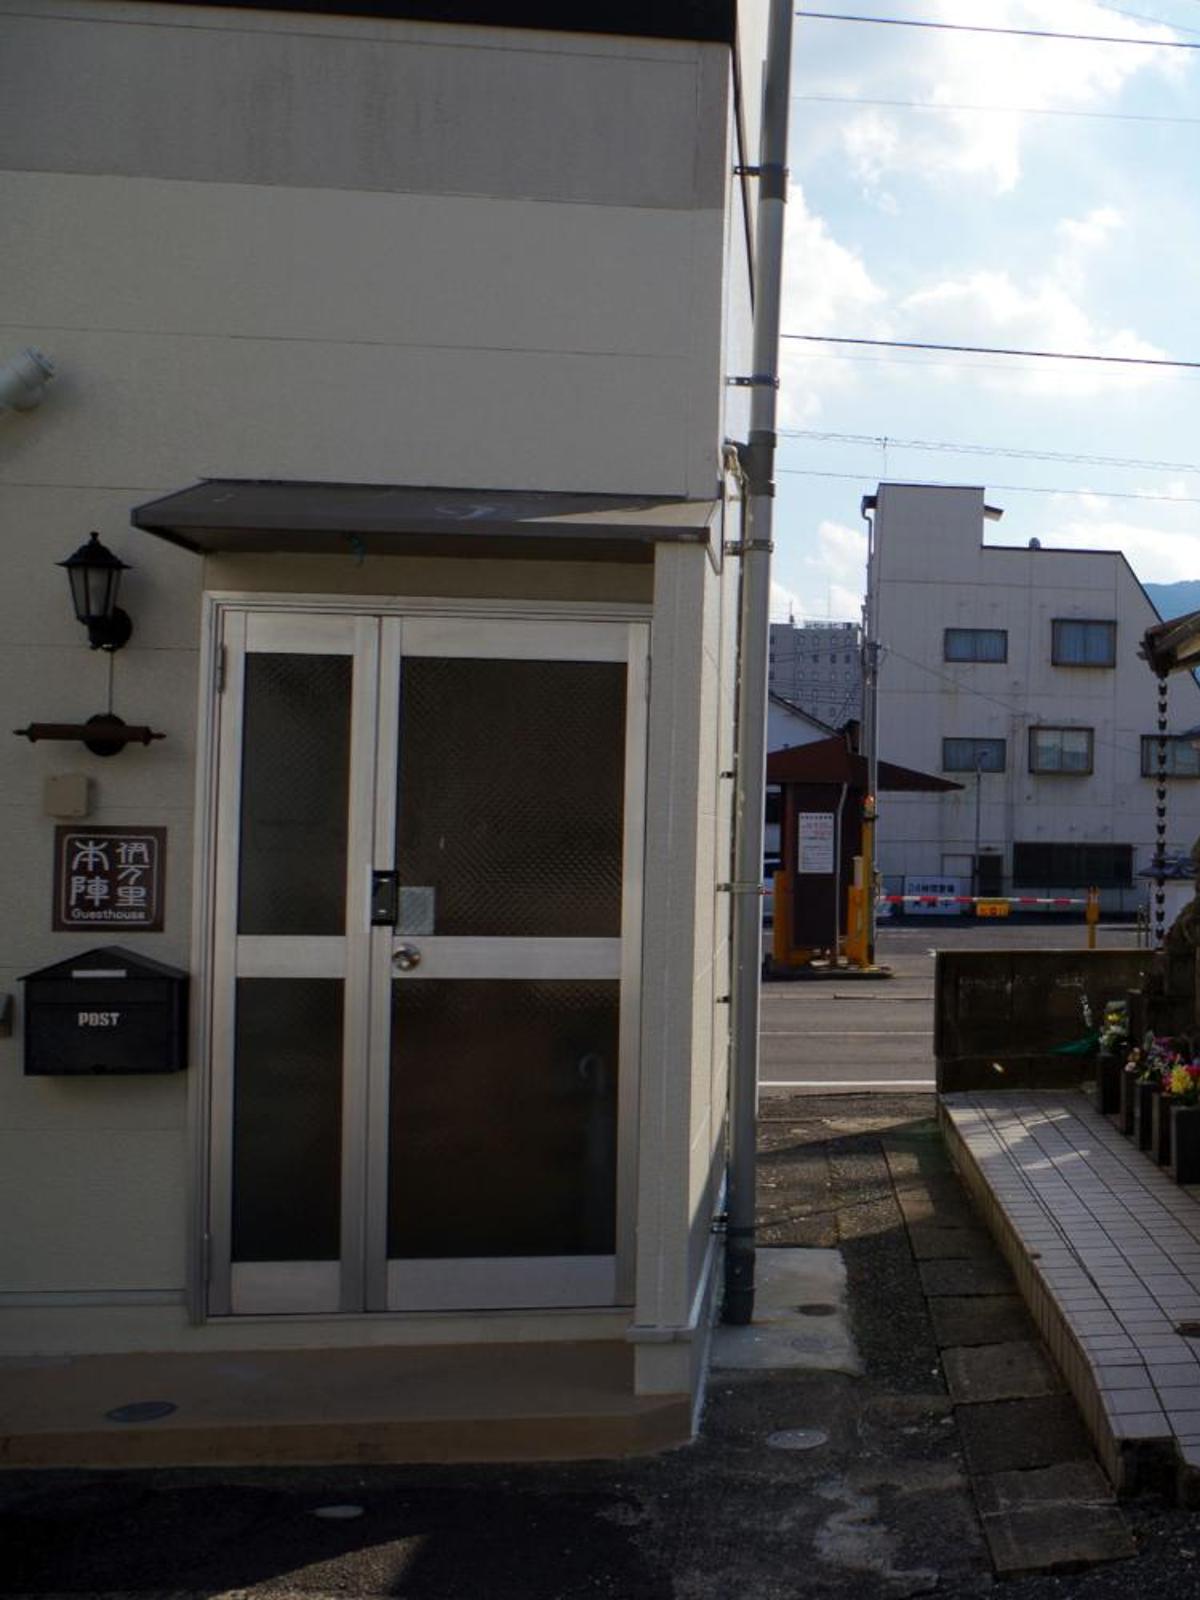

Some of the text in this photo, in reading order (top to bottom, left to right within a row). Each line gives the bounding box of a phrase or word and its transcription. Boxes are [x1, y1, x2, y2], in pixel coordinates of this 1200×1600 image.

[70, 840, 110, 907] 本陣
[115, 841, 151, 907] 伊万里
[71, 908, 146, 920] Guesthouse
[78, 1012, 121, 1026] POST
